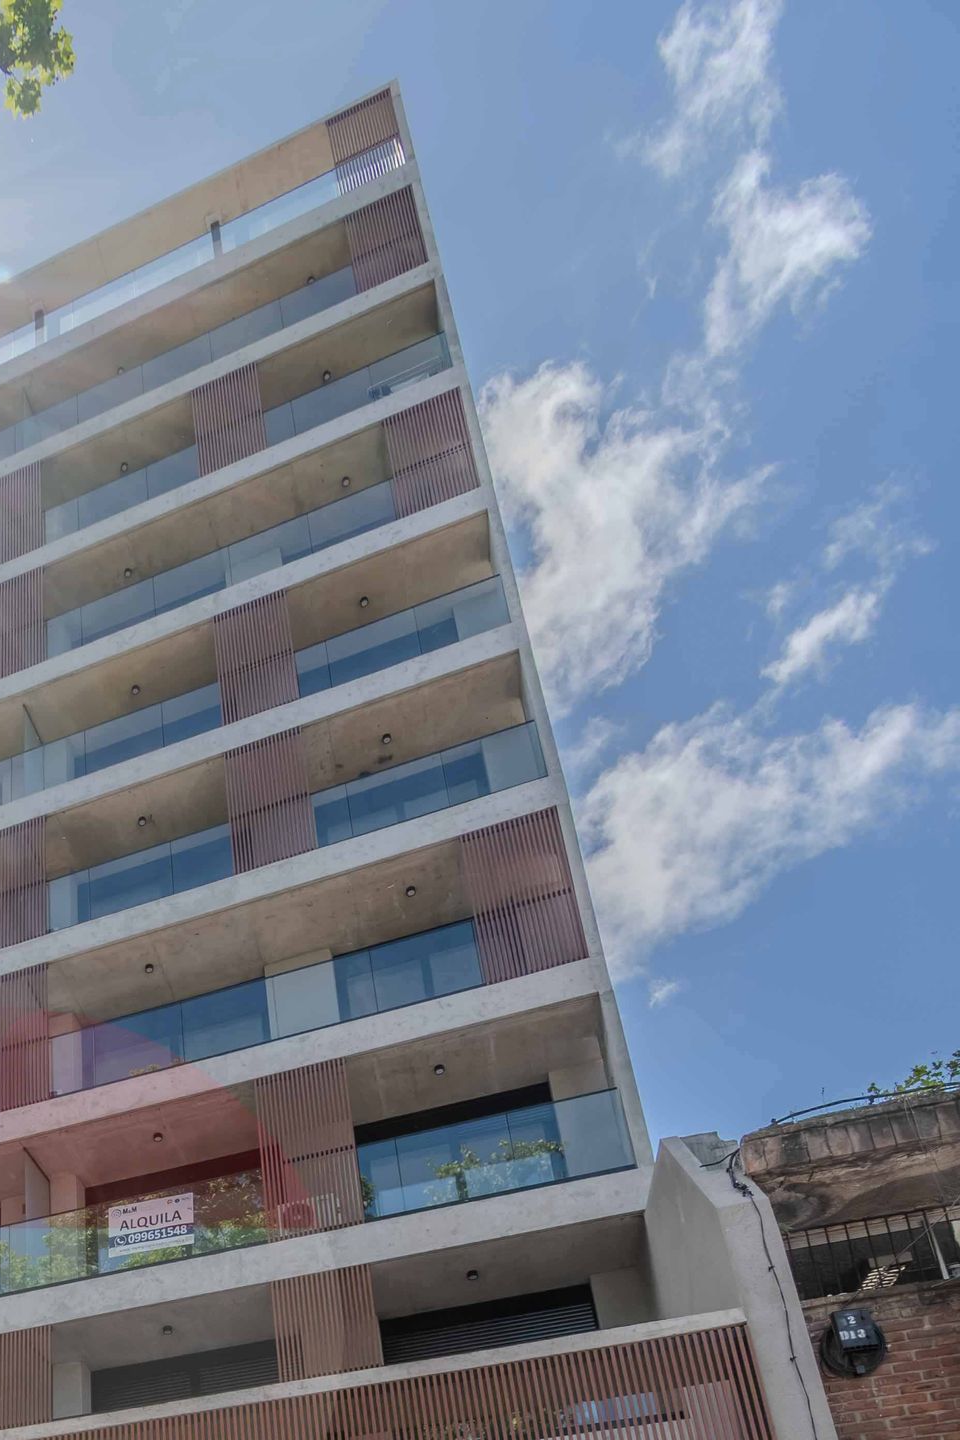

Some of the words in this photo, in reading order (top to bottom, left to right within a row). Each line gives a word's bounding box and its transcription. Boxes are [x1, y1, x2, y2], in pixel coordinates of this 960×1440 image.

[119, 1210, 182, 1232] ALQUILA
[128, 1225, 188, 1244] 099651548
[847, 1315, 857, 1324] 2
